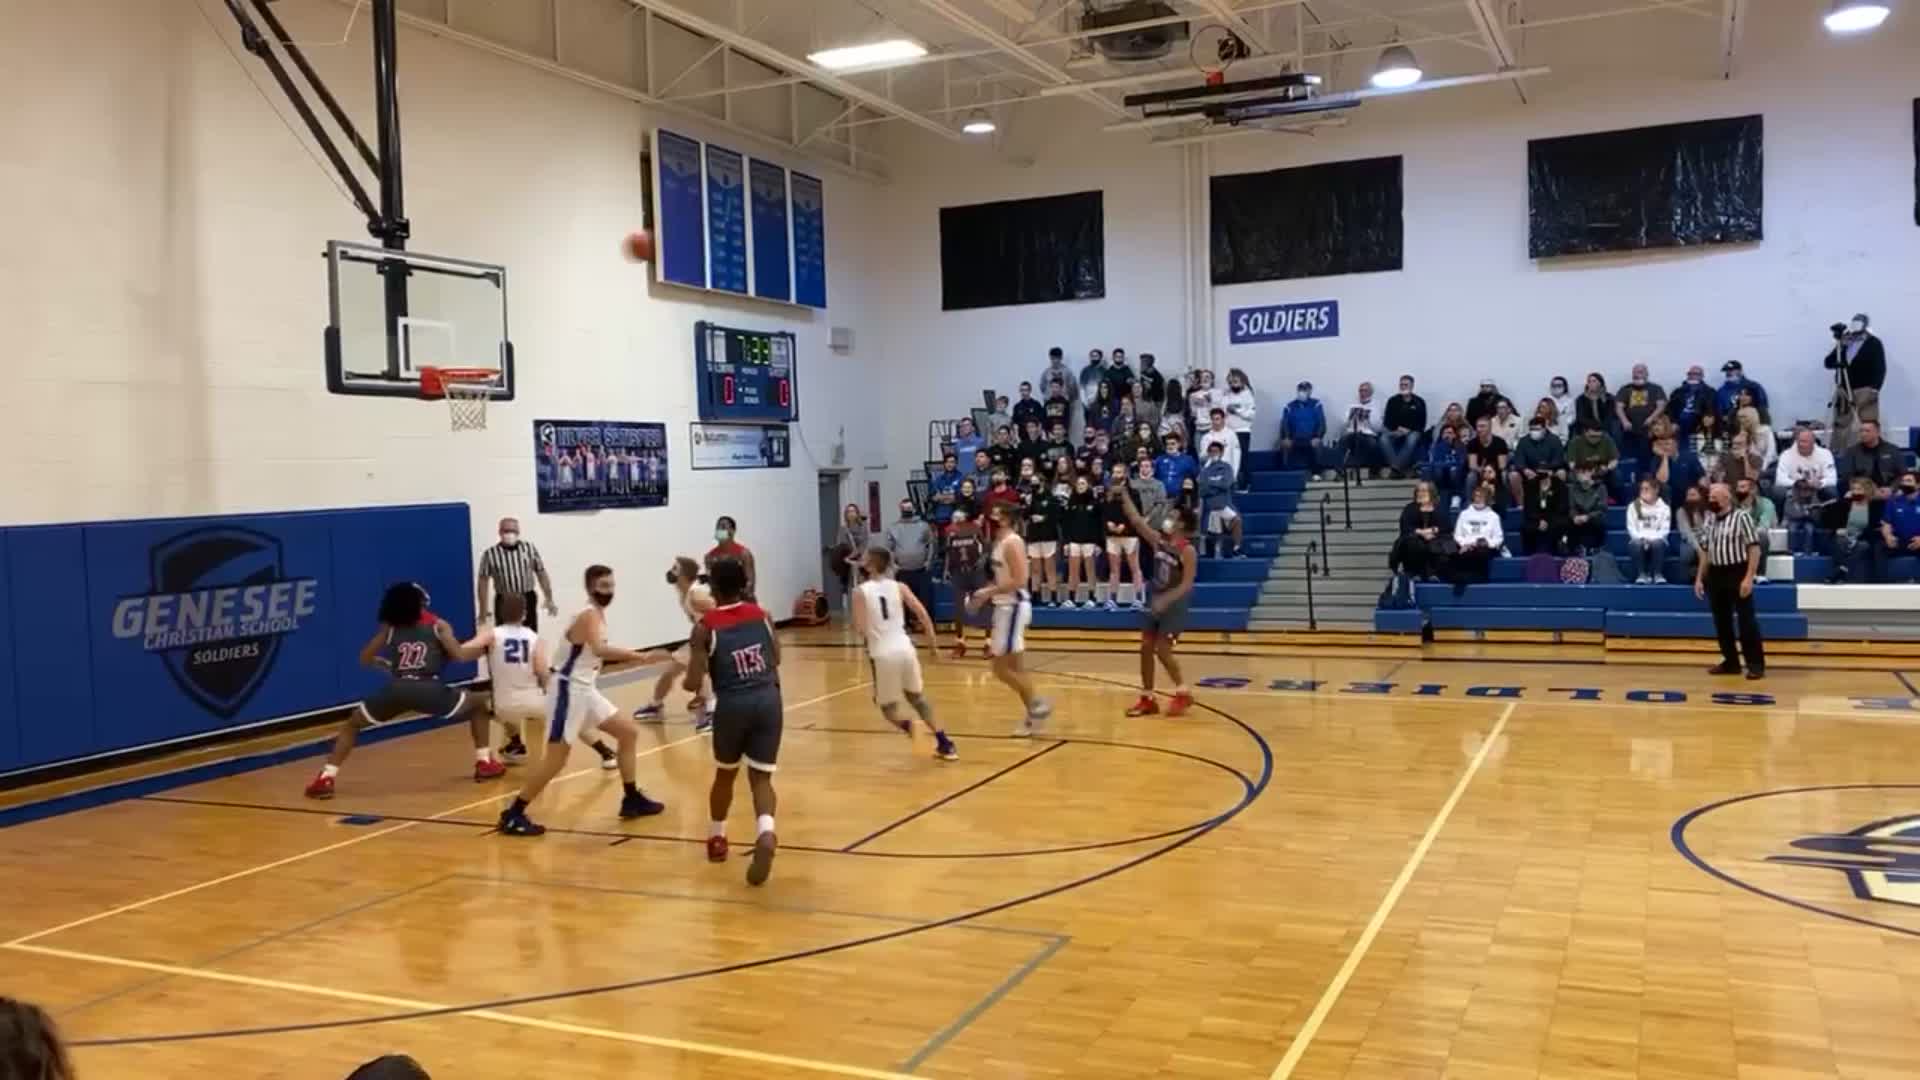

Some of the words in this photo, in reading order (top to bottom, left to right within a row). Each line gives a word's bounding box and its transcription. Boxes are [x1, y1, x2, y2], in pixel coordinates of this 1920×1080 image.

[1236, 306, 1330, 336] SOLDIERS
[724, 376, 734, 404] 0
[112, 579, 317, 638] GENESEE
[879, 595, 889, 620] 1
[143, 624, 235, 650] CHRISTIAN
[240, 615, 300, 637] SCHOOL
[193, 642, 260, 664] SOLDIERS
[398, 641, 427, 669] 22
[504, 638, 529, 664] 21
[731, 642, 767, 679] 13
[1195, 677, 1777, 705] SOLDIERS
